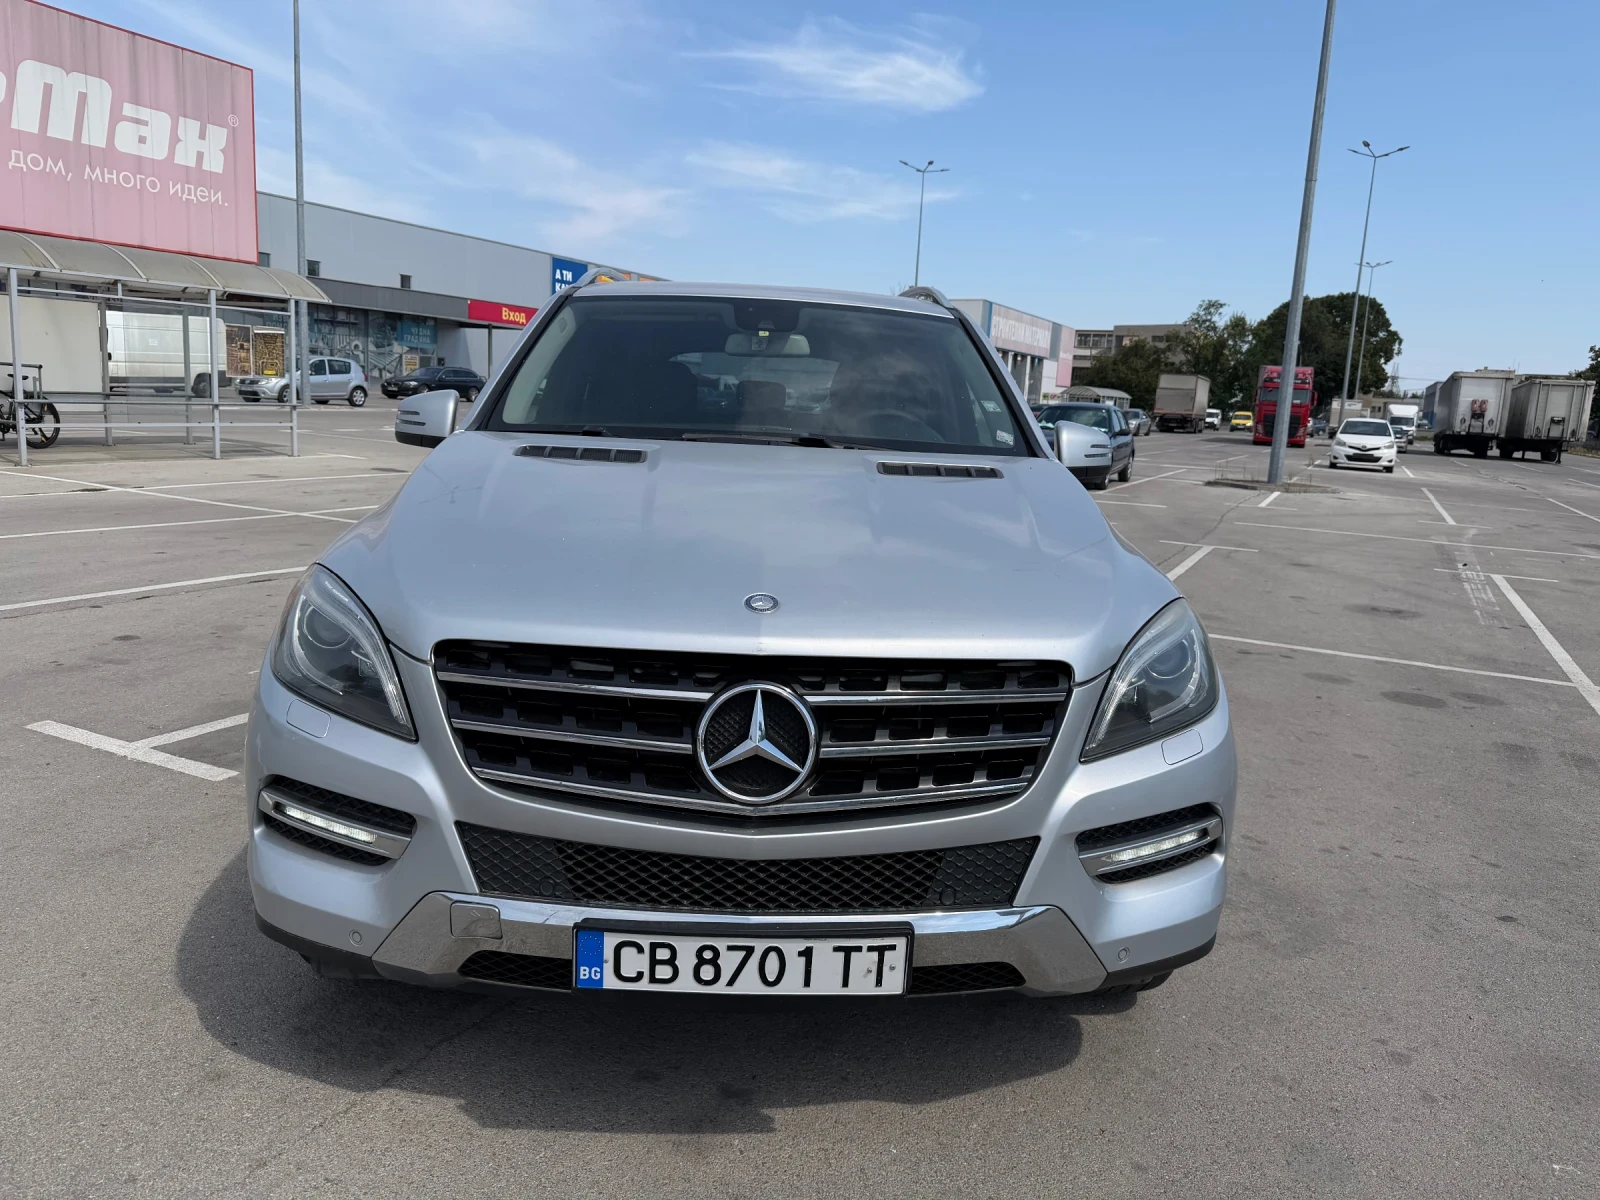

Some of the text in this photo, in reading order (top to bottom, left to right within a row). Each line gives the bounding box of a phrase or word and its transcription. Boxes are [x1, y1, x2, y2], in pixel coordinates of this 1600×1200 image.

[84, 164, 161, 193] много
[555, 269, 562, 280] А
[502, 307, 526, 325] Вход
[579, 966, 601, 980] BG
[613, 940, 897, 988] CB 8701 TT
